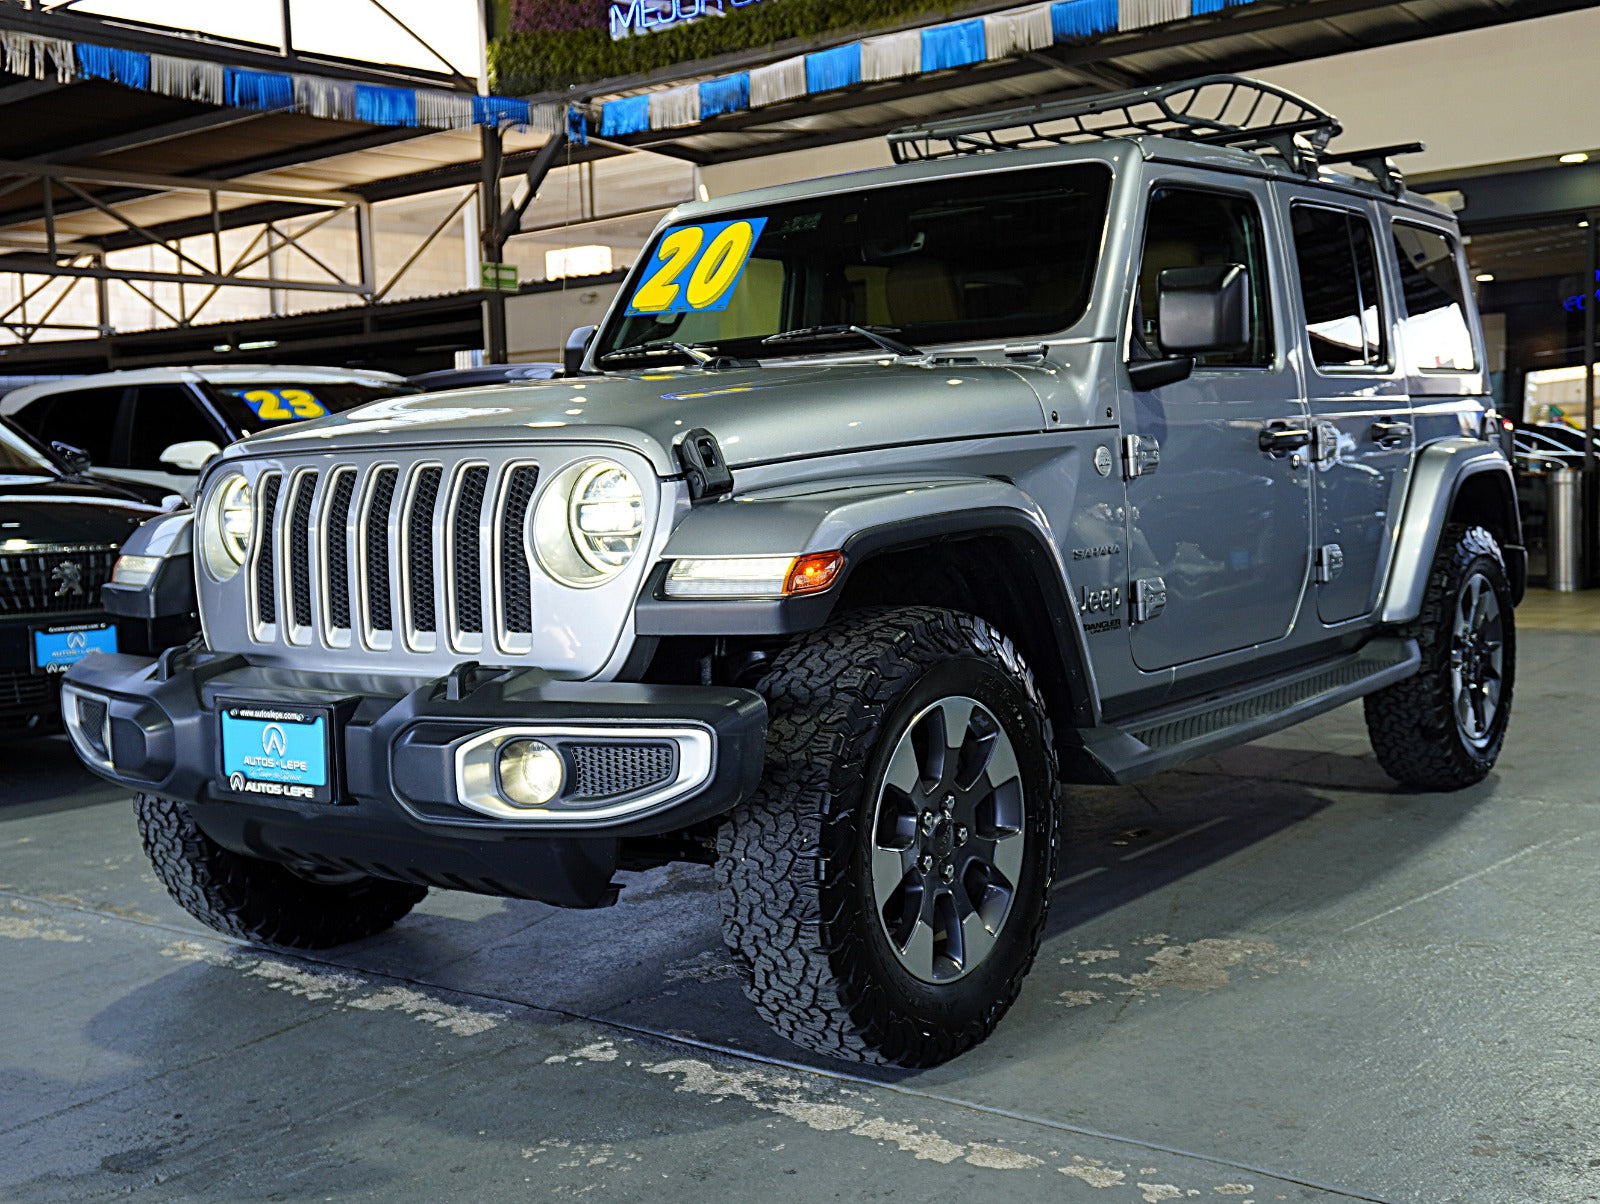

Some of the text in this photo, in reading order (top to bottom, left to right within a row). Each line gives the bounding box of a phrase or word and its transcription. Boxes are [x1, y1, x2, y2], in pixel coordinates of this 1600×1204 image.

[631, 220, 754, 312] 20
[243, 389, 325, 419] 23
[1073, 544, 1120, 560] SAHARA
[1079, 586, 1120, 616] Jeep
